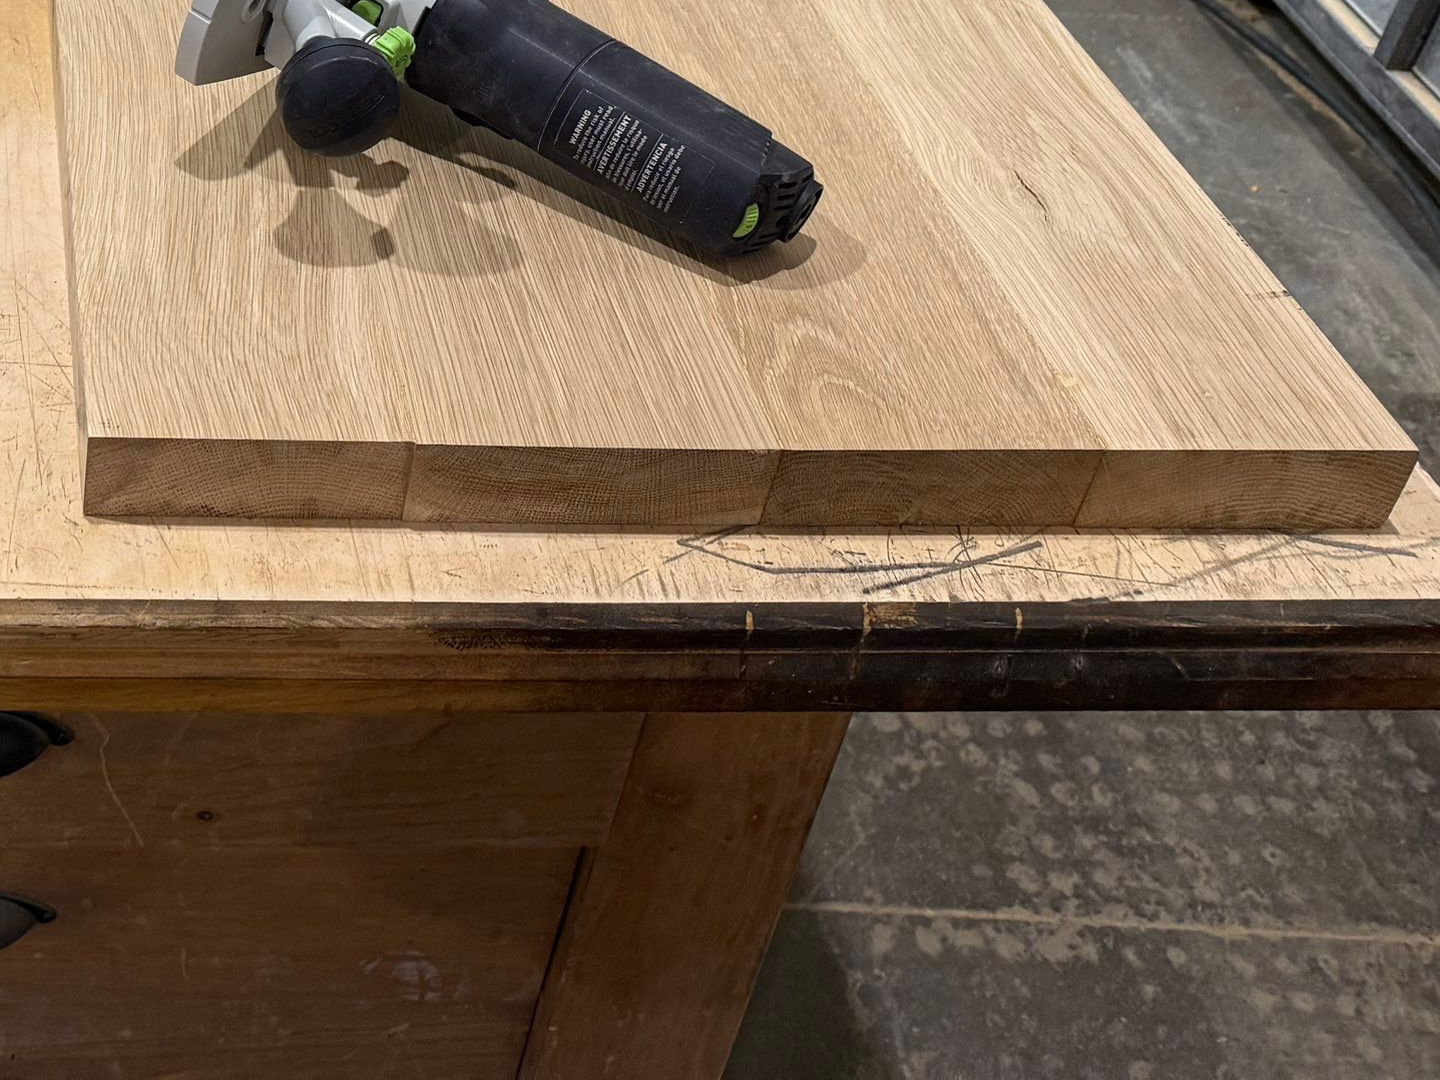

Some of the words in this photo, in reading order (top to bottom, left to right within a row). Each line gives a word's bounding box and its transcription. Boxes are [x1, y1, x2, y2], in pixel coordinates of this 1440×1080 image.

[569, 109, 592, 145] WARNING
[576, 136, 588, 154] reduce
[590, 113, 600, 126] risk
[594, 120, 605, 135] must
[596, 114, 632, 174] AVERTISSEMENT
[626, 119, 640, 138] risque
[636, 141, 668, 193] ADVERTENCIA
[674, 144, 686, 160] debe
